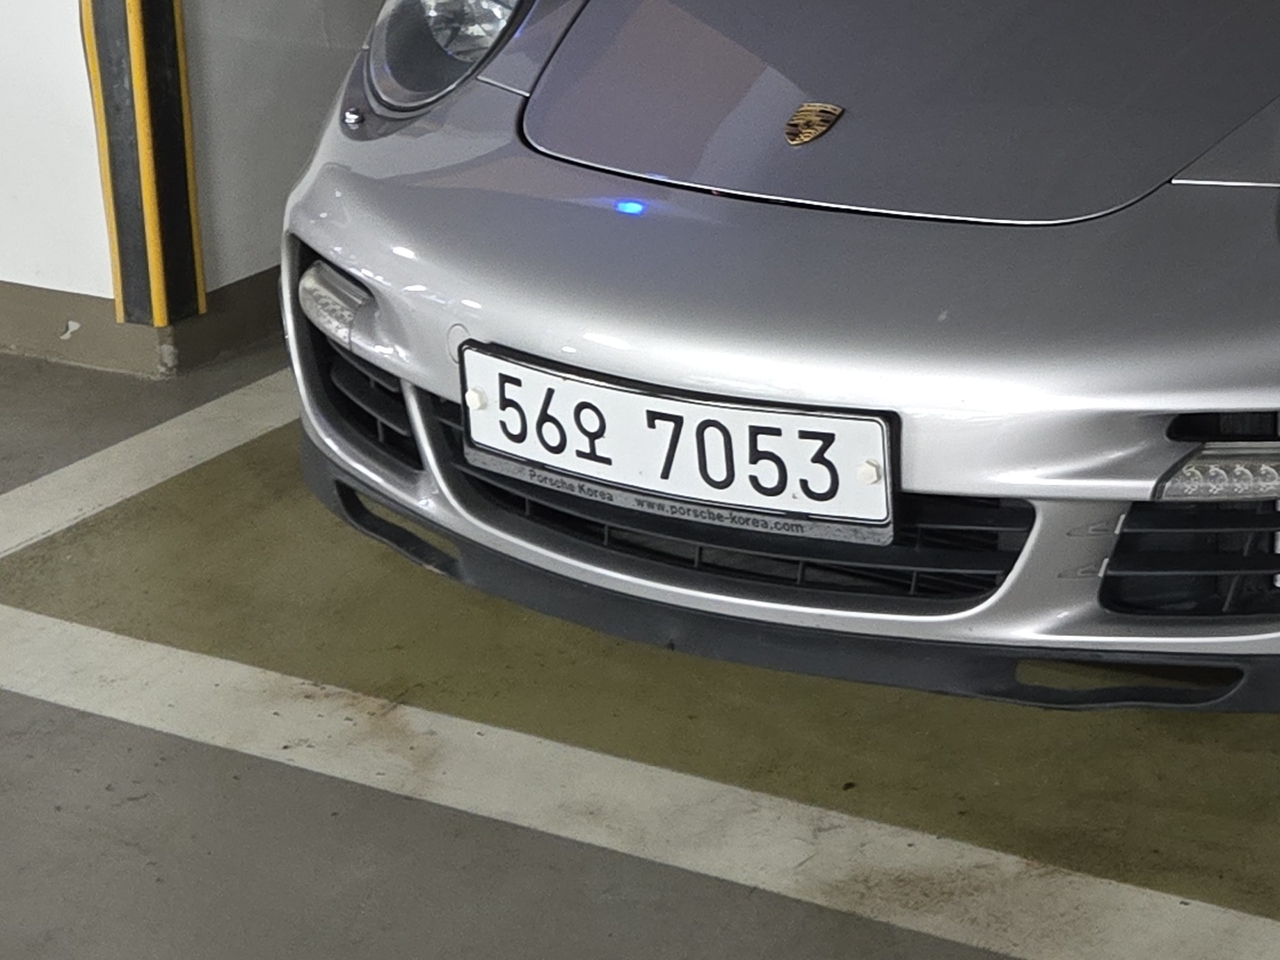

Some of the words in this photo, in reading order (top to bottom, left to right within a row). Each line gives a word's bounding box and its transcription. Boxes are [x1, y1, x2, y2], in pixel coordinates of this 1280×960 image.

[498, 373, 612, 465] 56오
[646, 410, 840, 502] 7053
[528, 468, 576, 492] Porsche
[577, 483, 614, 502] Korea
[634, 496, 804, 534] www.porsche-korea.com
